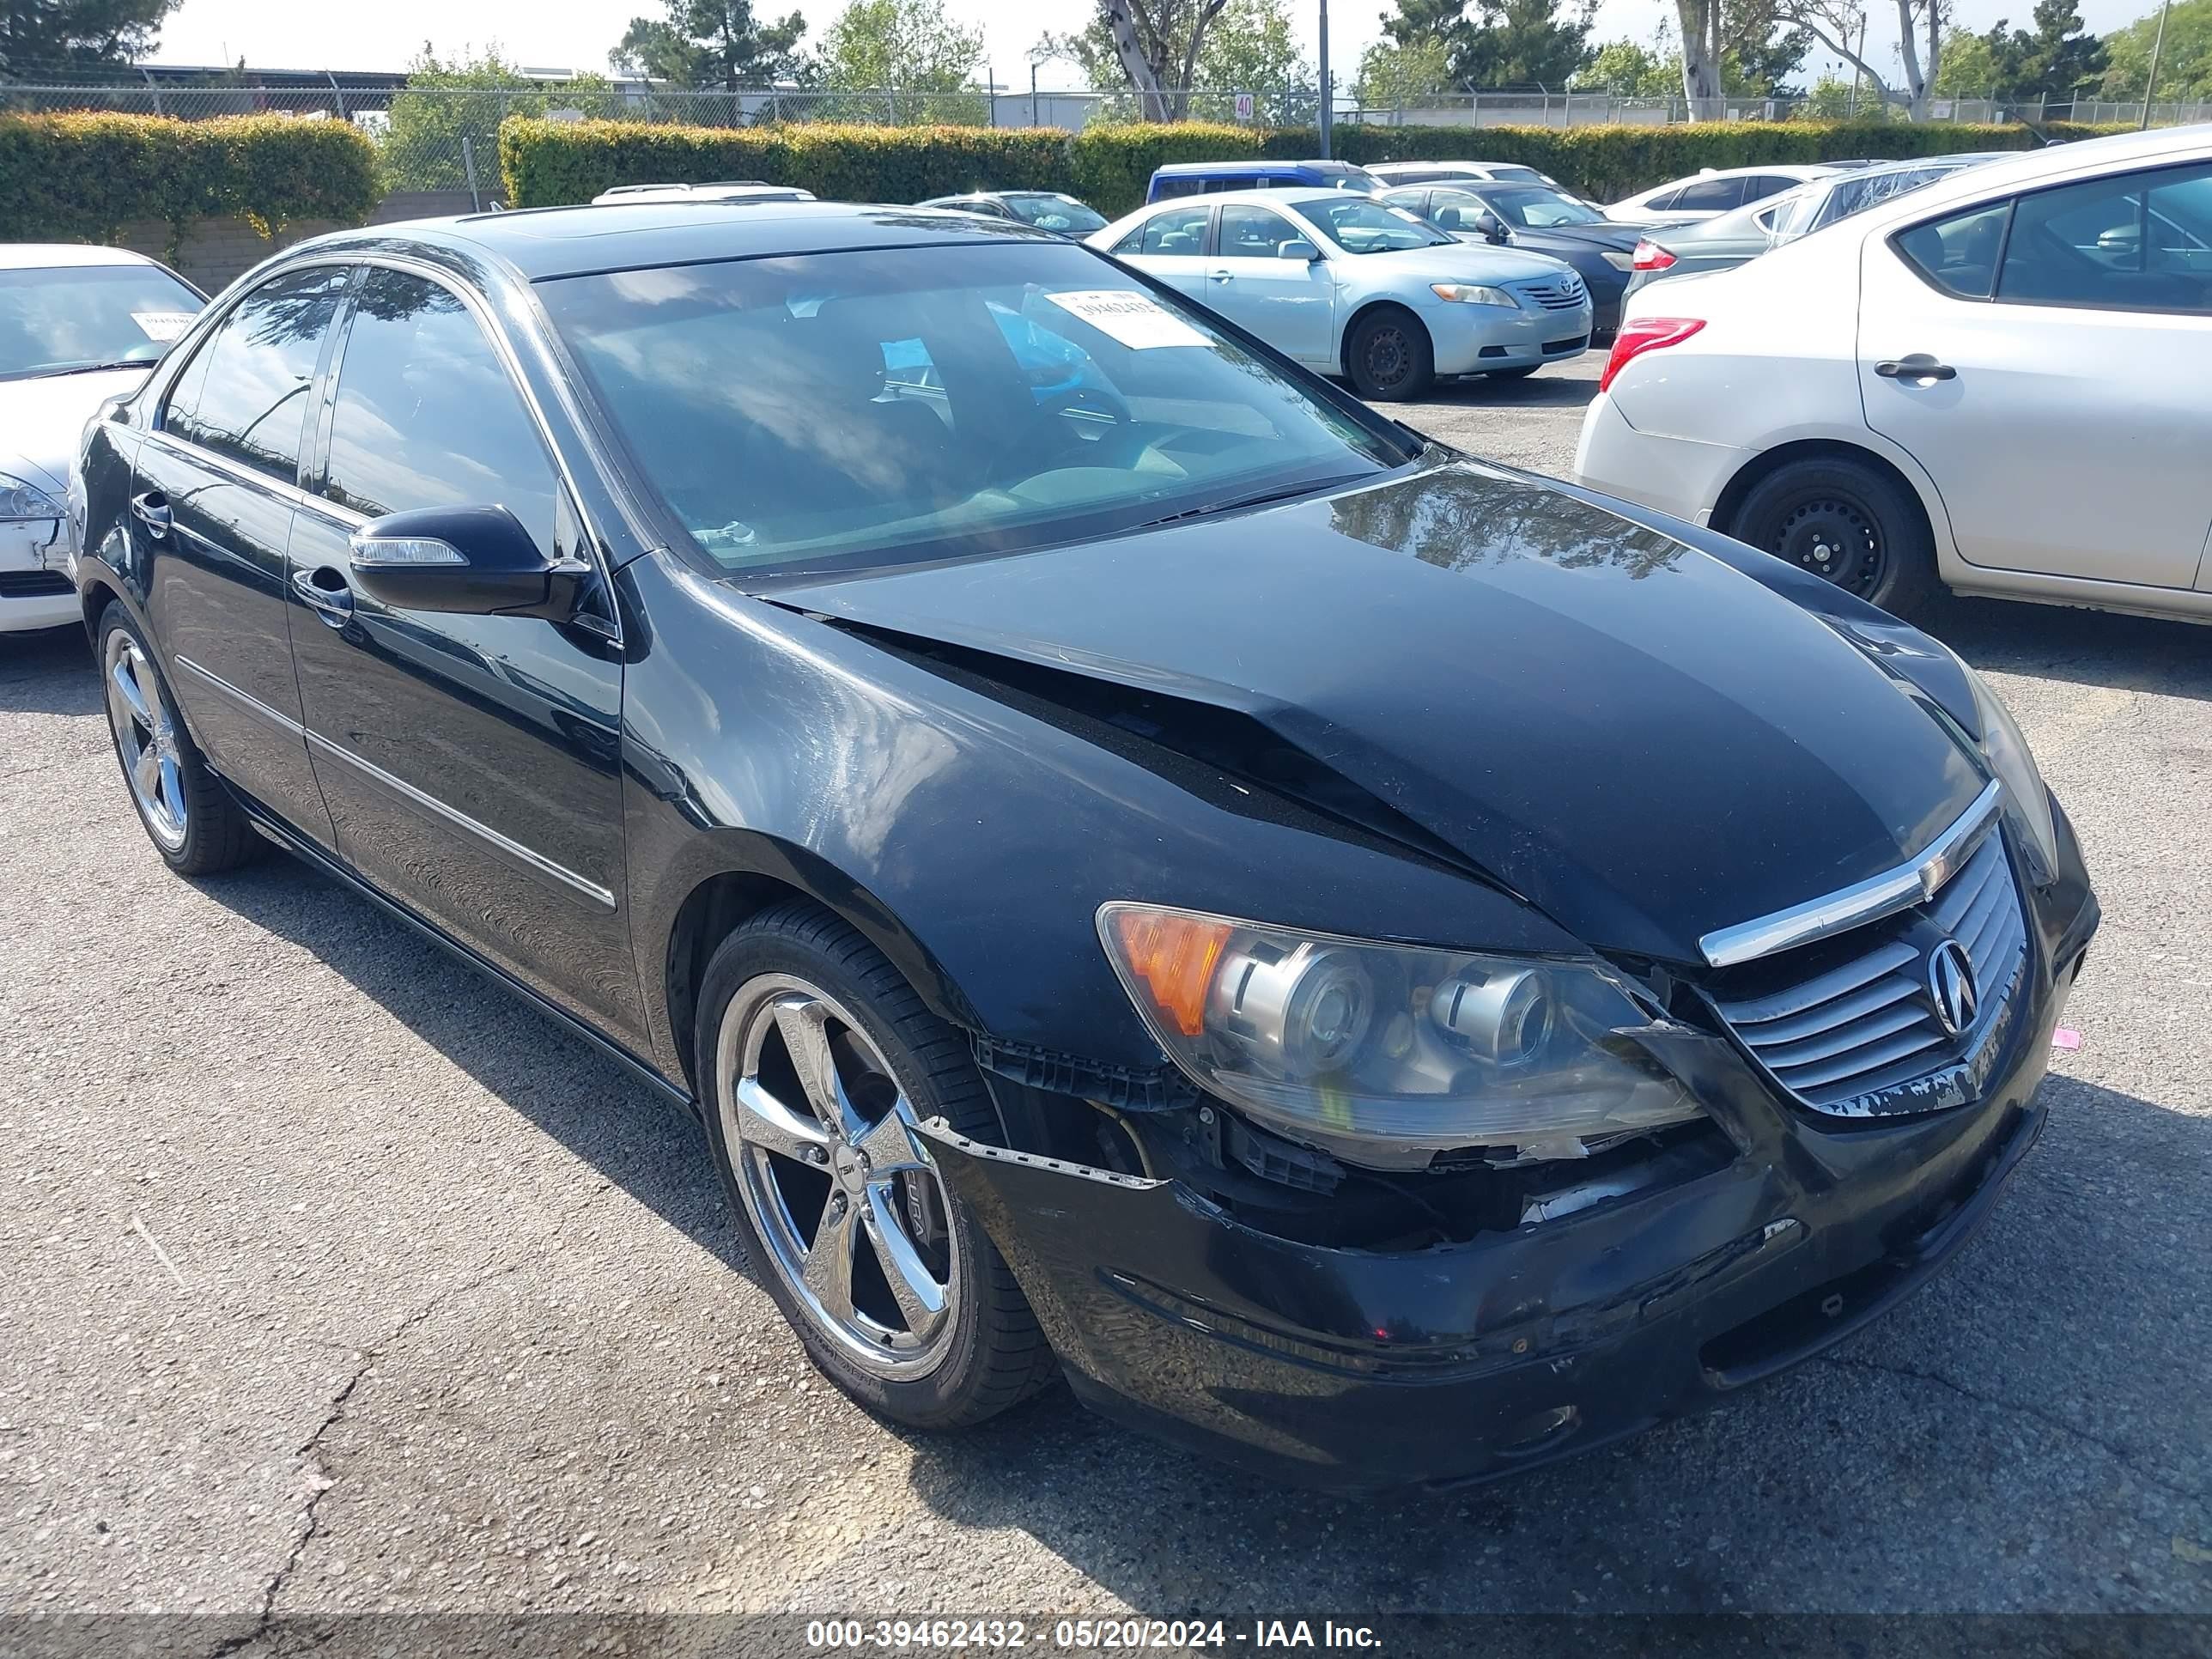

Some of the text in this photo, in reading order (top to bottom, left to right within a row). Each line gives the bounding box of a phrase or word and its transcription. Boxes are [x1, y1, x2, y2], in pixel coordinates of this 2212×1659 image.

[1237, 96, 1251, 117] 40
[1076, 301, 1156, 316] 39462432
[838, 1163, 855, 1176] TSW
[906, 1169, 925, 1237] CURA
